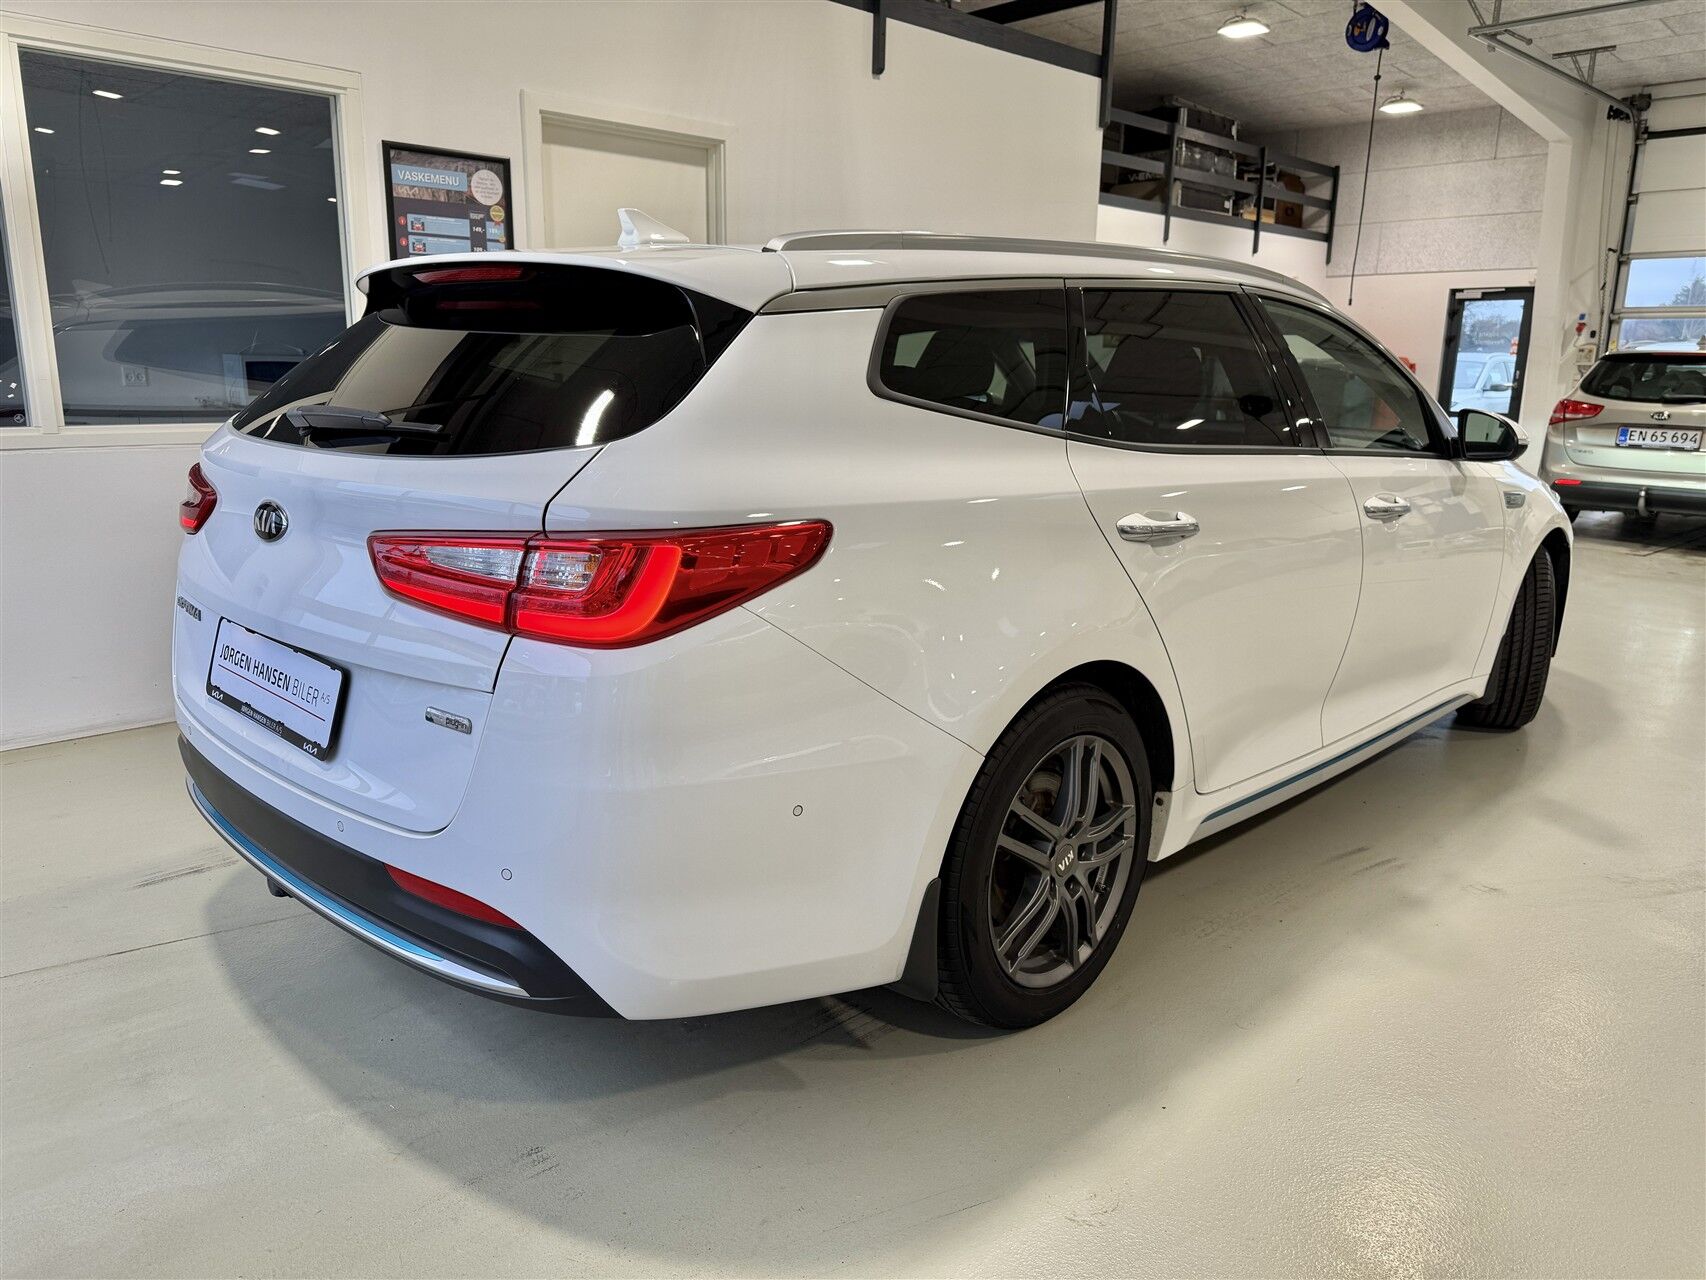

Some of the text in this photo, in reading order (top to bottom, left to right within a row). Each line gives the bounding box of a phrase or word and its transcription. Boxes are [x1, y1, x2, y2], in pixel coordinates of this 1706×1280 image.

[397, 170, 460, 186] VASKEMENU
[1628, 429, 1698, 445] EN 65 694
[254, 508, 277, 534] KIA
[220, 643, 252, 673] JØRGEN
[252, 659, 291, 692] HANSEN
[291, 678, 320, 707] BILER
[1058, 850, 1074, 871] KIA
